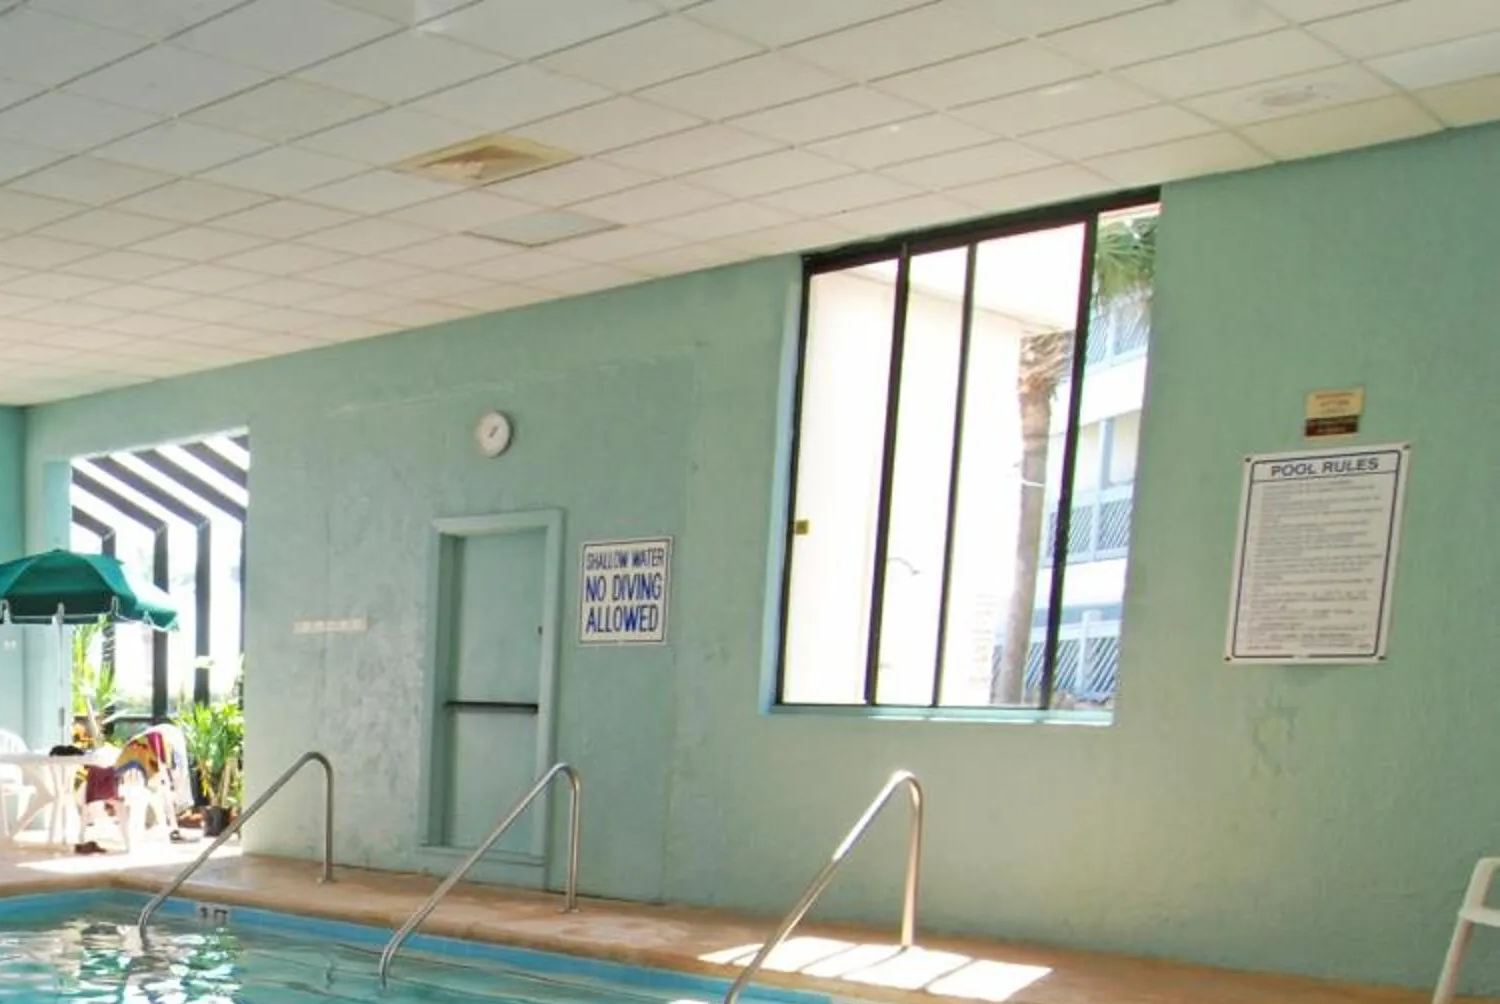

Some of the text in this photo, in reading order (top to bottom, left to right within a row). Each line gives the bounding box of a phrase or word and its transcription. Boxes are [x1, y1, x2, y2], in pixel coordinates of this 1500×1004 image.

[1271, 457, 1379, 477] POOL RULES
[586, 547, 665, 571] SHALLOW WATER
[585, 572, 662, 602] NO DIVING
[585, 604, 659, 634] ALLOWED
